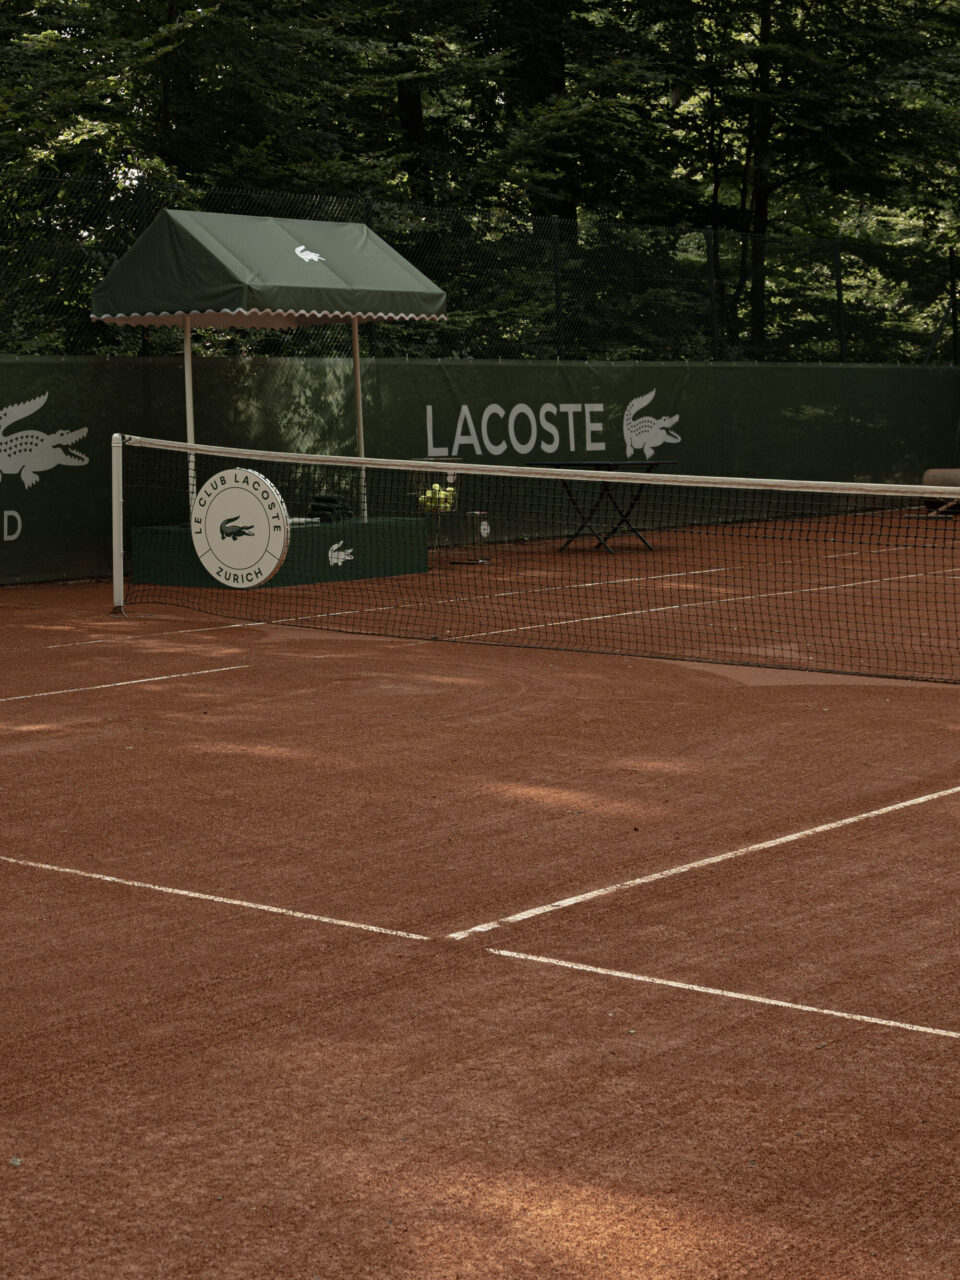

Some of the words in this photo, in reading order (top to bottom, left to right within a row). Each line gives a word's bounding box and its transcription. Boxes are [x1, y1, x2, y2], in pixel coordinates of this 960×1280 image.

[426, 403, 605, 456] LACOSTE
[194, 517, 203, 534] LE
[199, 475, 227, 507] CLUB
[234, 473, 281, 532] LACOSTE
[216, 566, 263, 584] ZURICH
